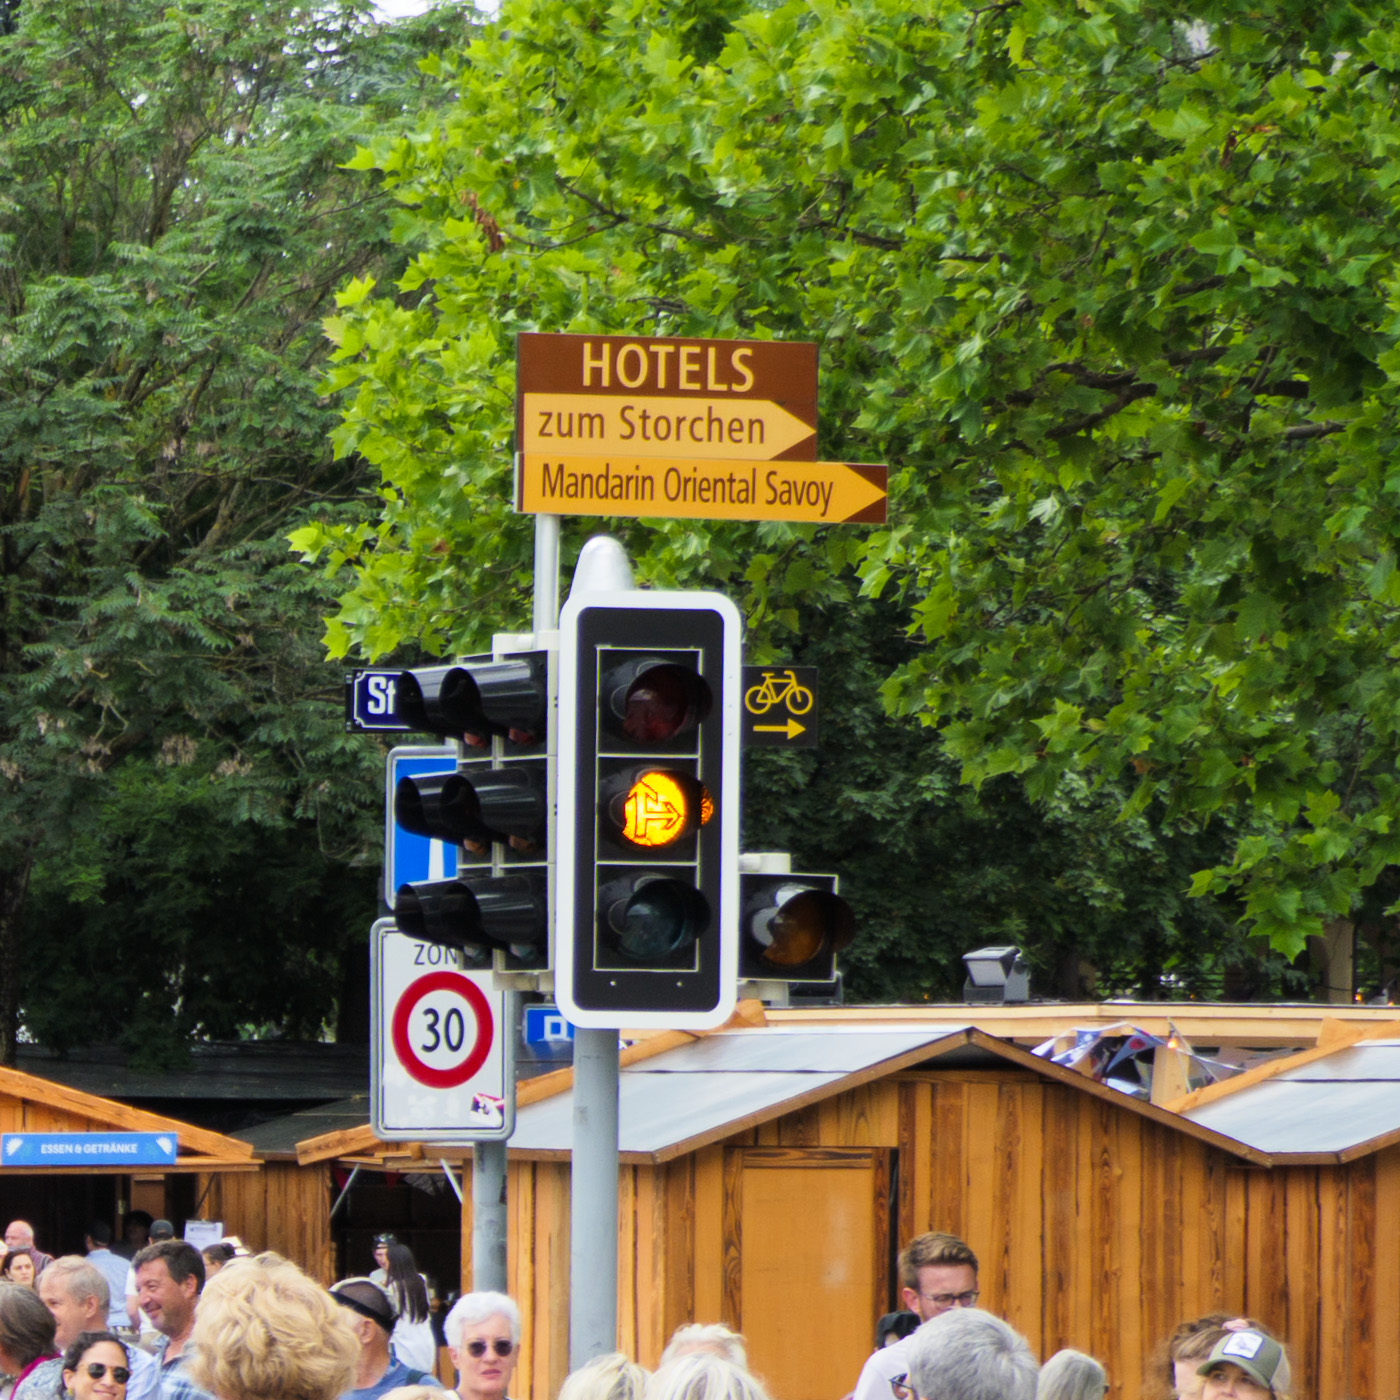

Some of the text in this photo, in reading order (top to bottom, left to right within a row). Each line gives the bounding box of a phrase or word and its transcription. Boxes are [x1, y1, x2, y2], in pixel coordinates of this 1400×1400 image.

[582, 342, 755, 392] HOTELS
[538, 405, 765, 444] zum Storchen
[542, 462, 834, 517] Mandarin Oriental Savoy
[367, 676, 395, 715] St
[413, 943, 458, 967] ZON
[421, 1007, 464, 1053] 30
[40, 1143, 72, 1155] ESSEN
[84, 1142, 138, 1155] GETRÄNKE
